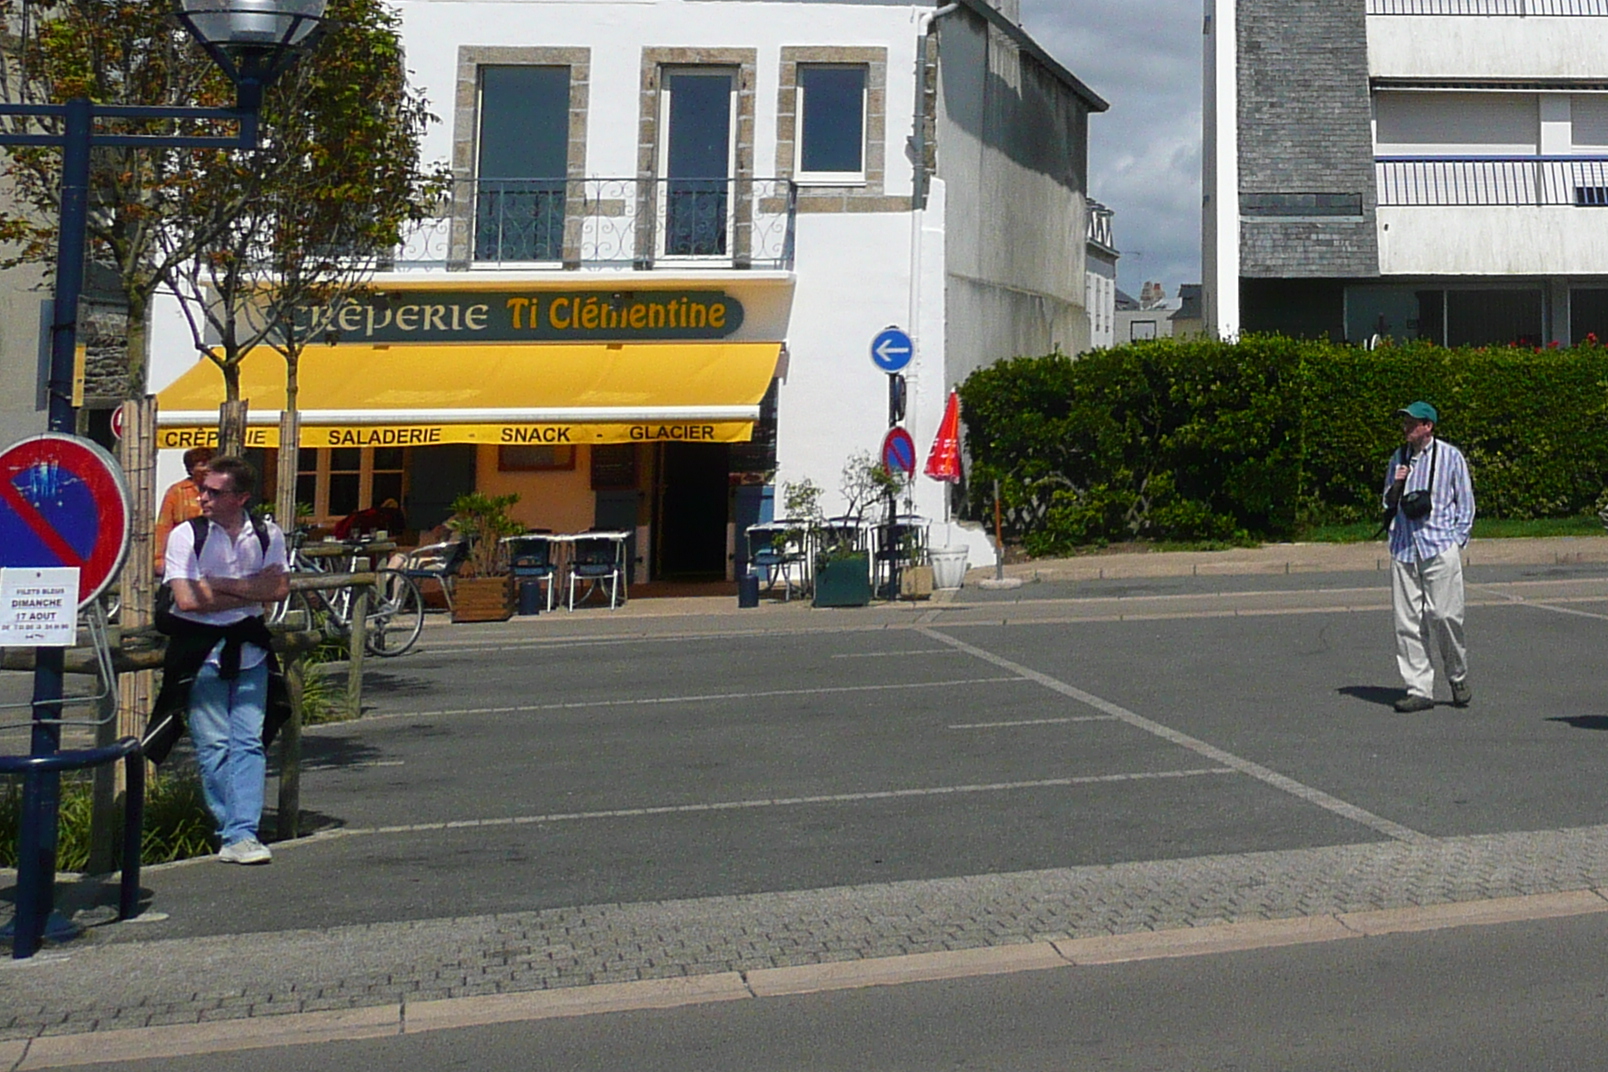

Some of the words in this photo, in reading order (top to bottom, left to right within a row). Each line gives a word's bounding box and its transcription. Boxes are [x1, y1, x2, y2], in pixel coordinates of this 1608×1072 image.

[506, 297, 539, 328] Ti
[549, 297, 727, 328] Clémentine
[165, 428, 267, 446] CRÊPIE
[328, 428, 441, 446] SALADERIE
[500, 427, 571, 442] SNACK
[629, 426, 715, 440] GLACIER
[11, 599, 63, 608] DIMANCHE
[29, 612, 57, 620] AOUT
